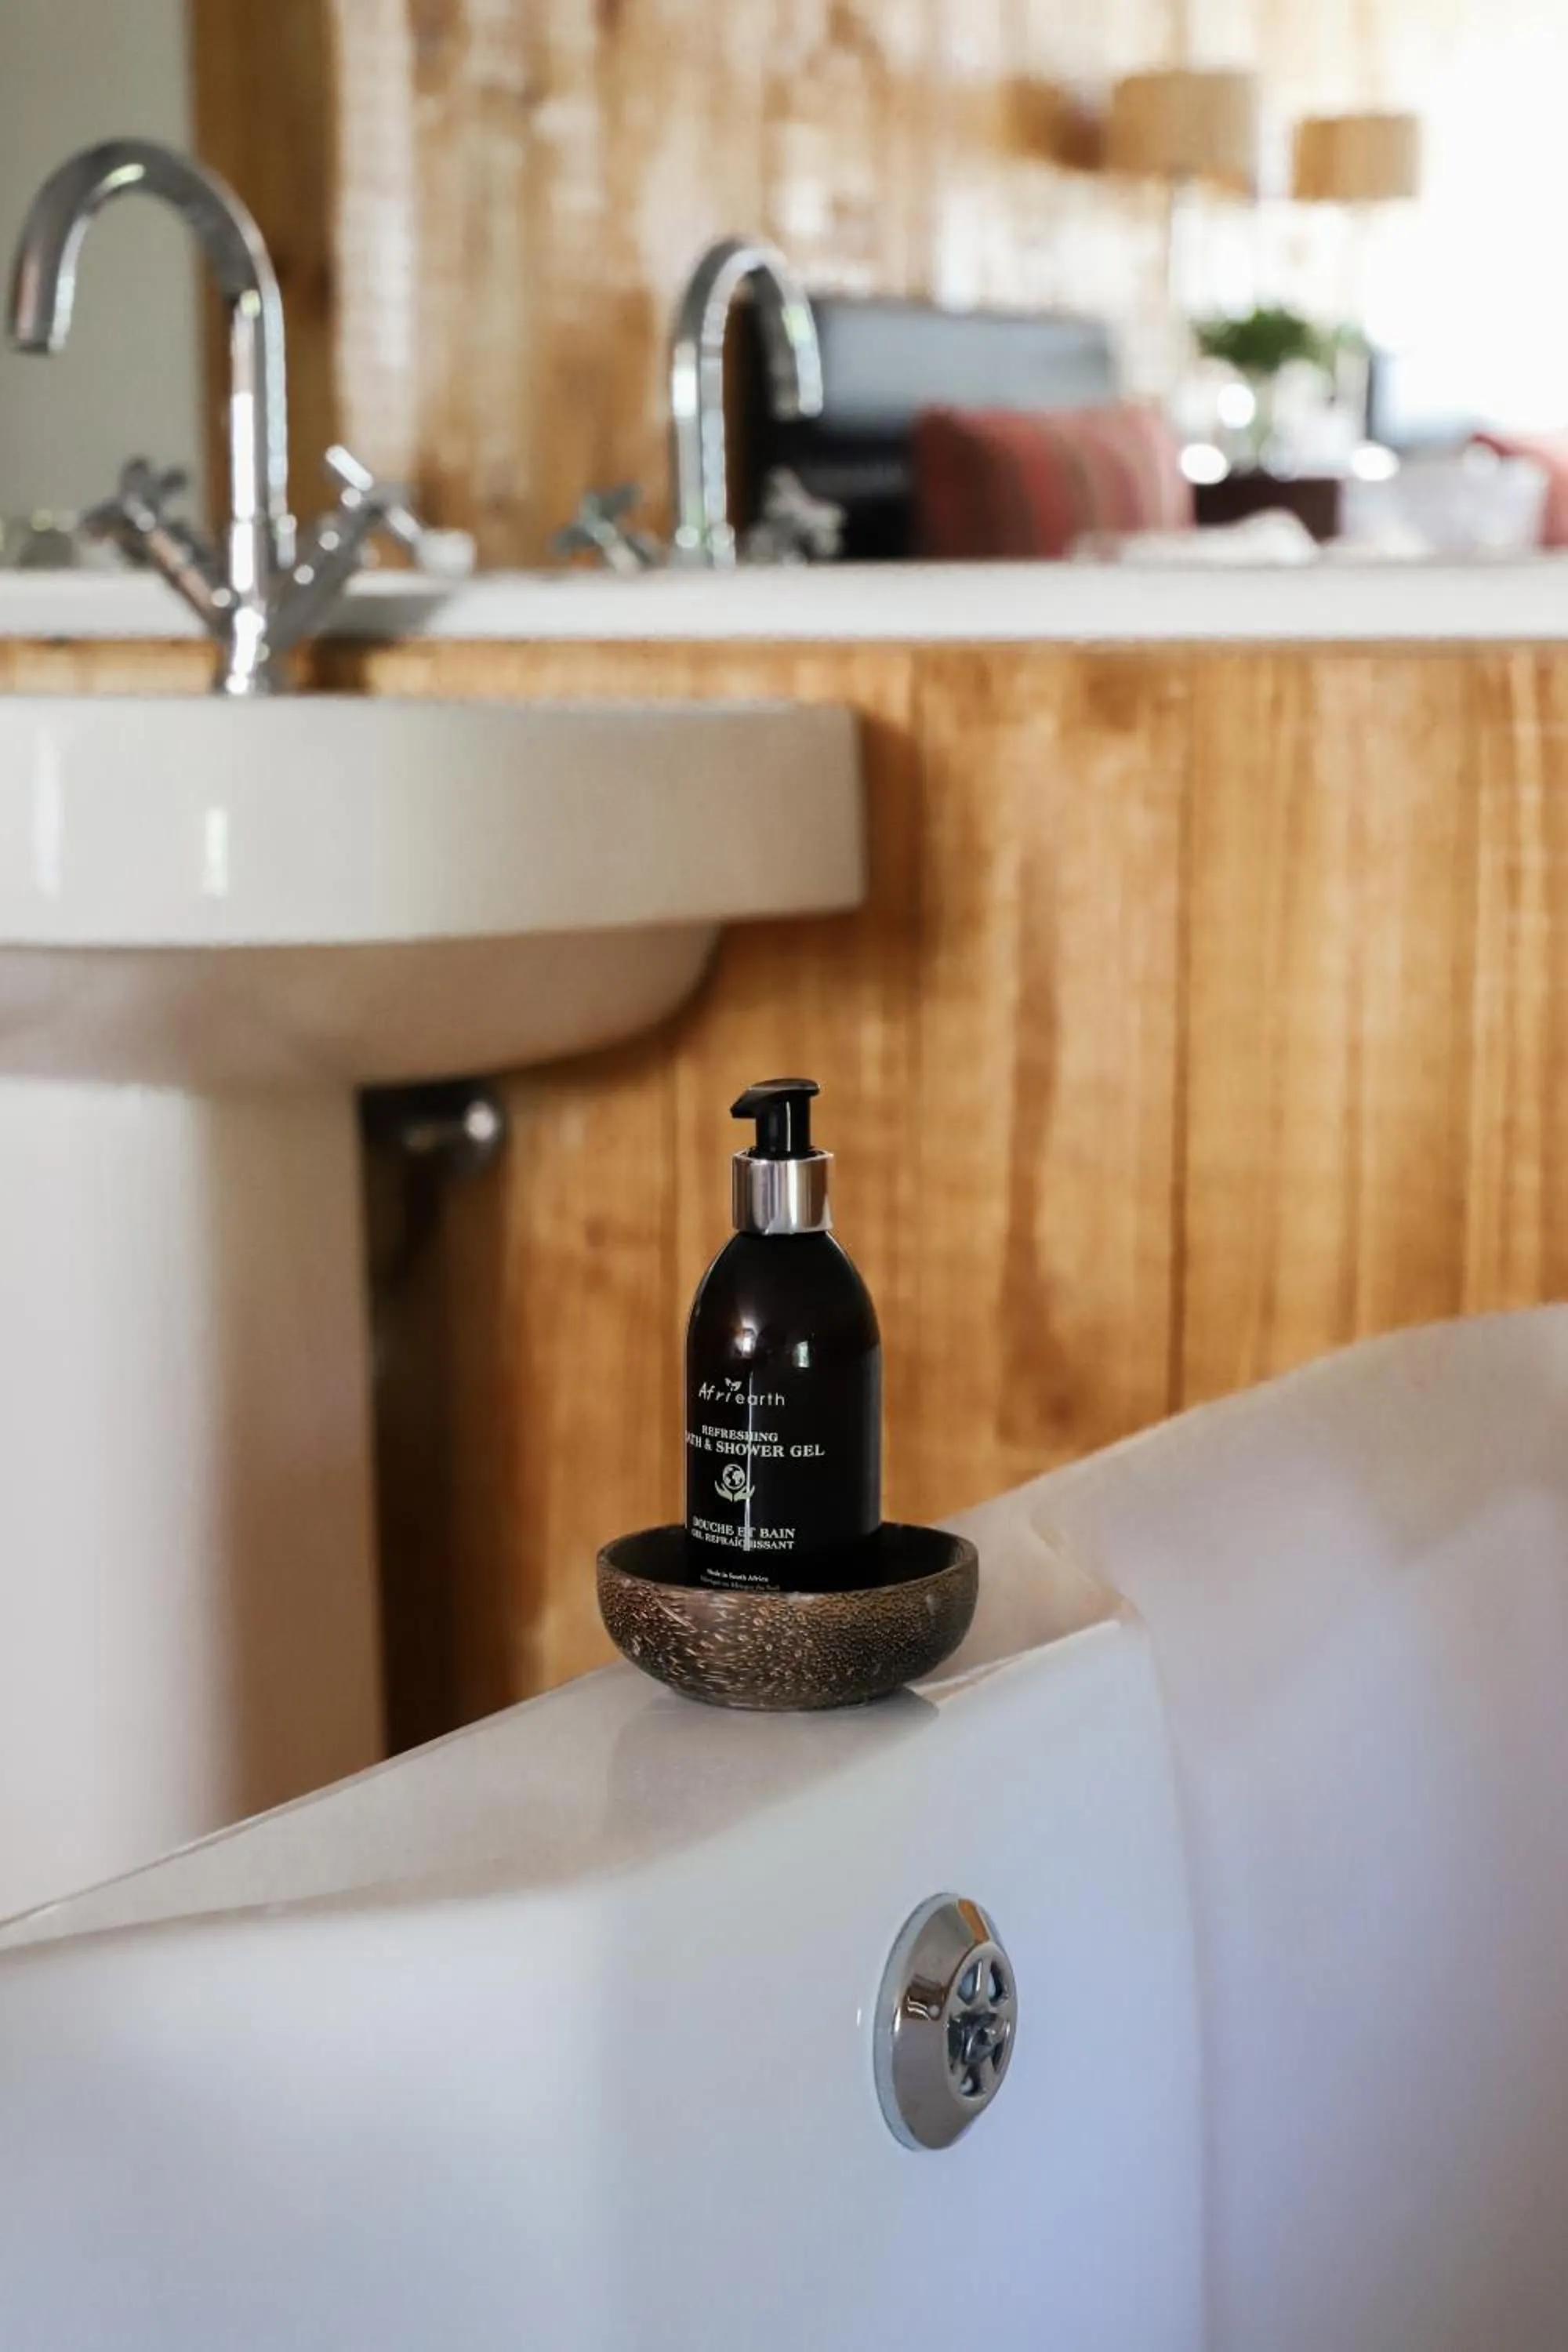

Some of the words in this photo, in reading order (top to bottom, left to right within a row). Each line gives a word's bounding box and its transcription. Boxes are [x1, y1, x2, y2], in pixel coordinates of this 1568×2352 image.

[702, 1425, 779, 1443] REFRESHING
[704, 1438, 712, 1451] &
[716, 1440, 785, 1457] SHOWER
[789, 1444, 826, 1457] GEL
[692, 1516, 734, 1536] DOUCHE
[738, 1526, 756, 1537] ET
[760, 1528, 796, 1539] BAIN
